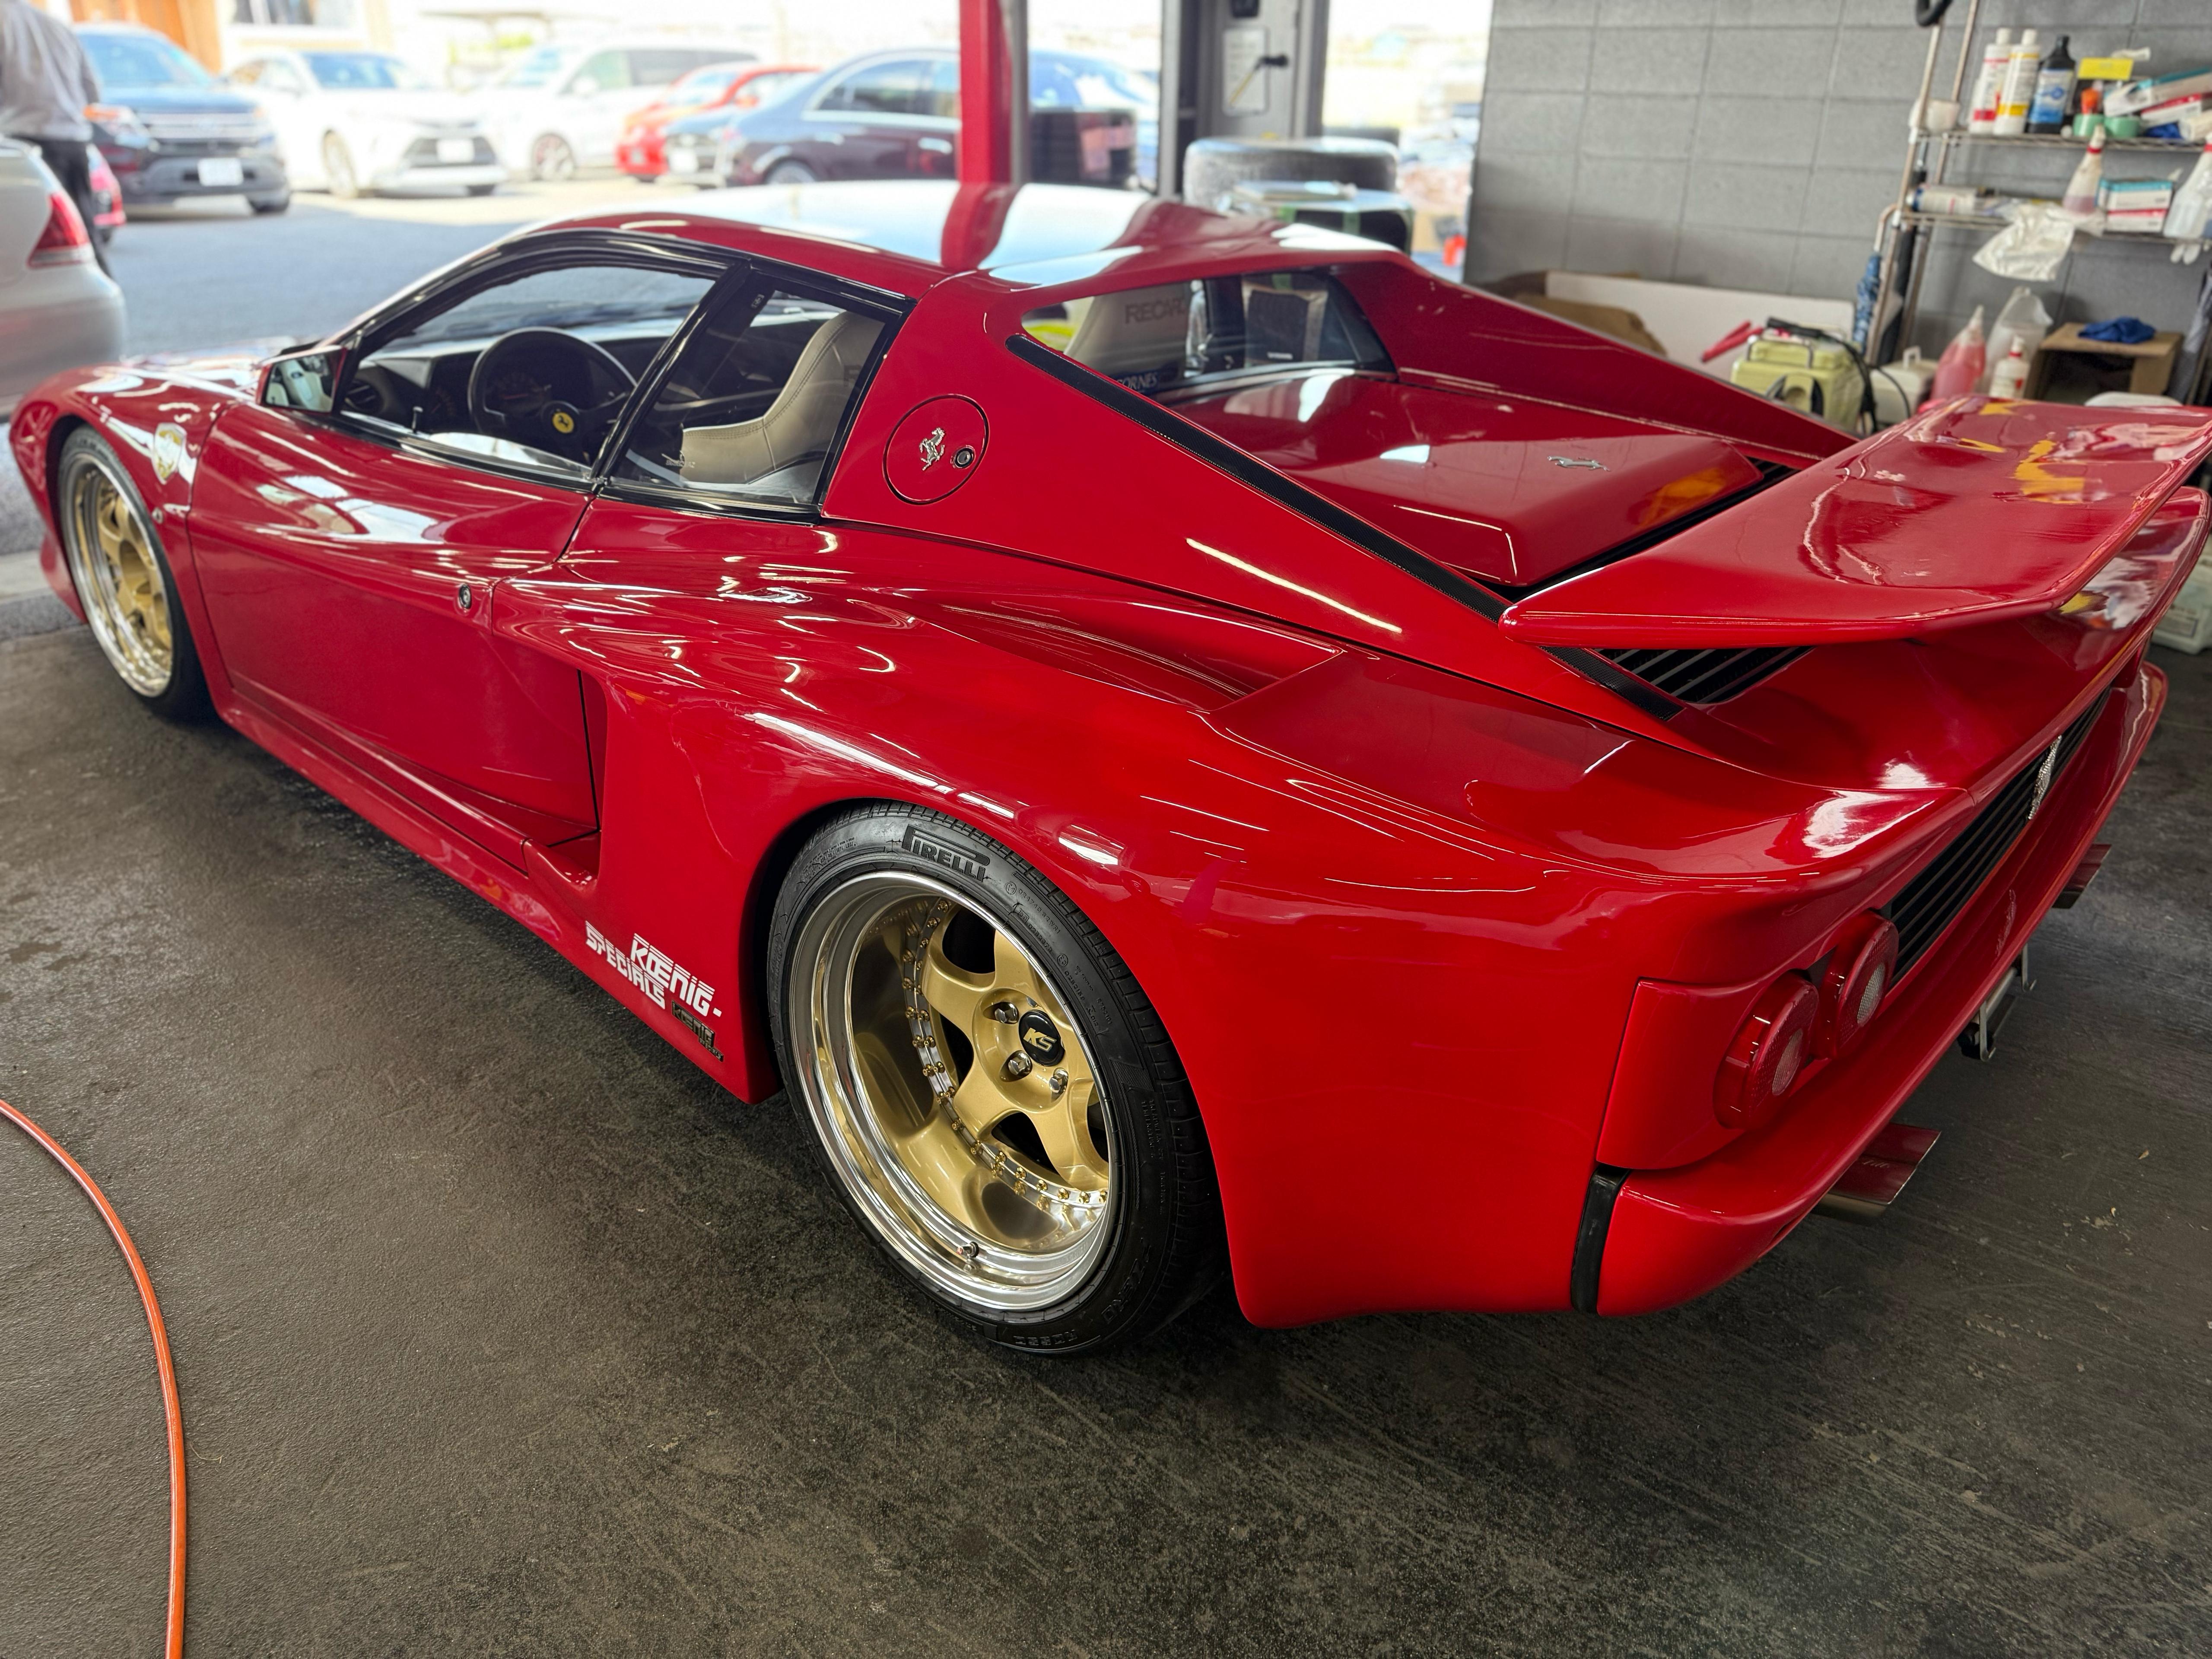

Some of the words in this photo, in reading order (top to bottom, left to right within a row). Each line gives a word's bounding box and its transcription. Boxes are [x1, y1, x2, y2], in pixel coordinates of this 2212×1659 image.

[1125, 298, 1186, 324] RECAR
[902, 824, 990, 882] PIRELLI
[1023, 1027, 1057, 1052] KS
